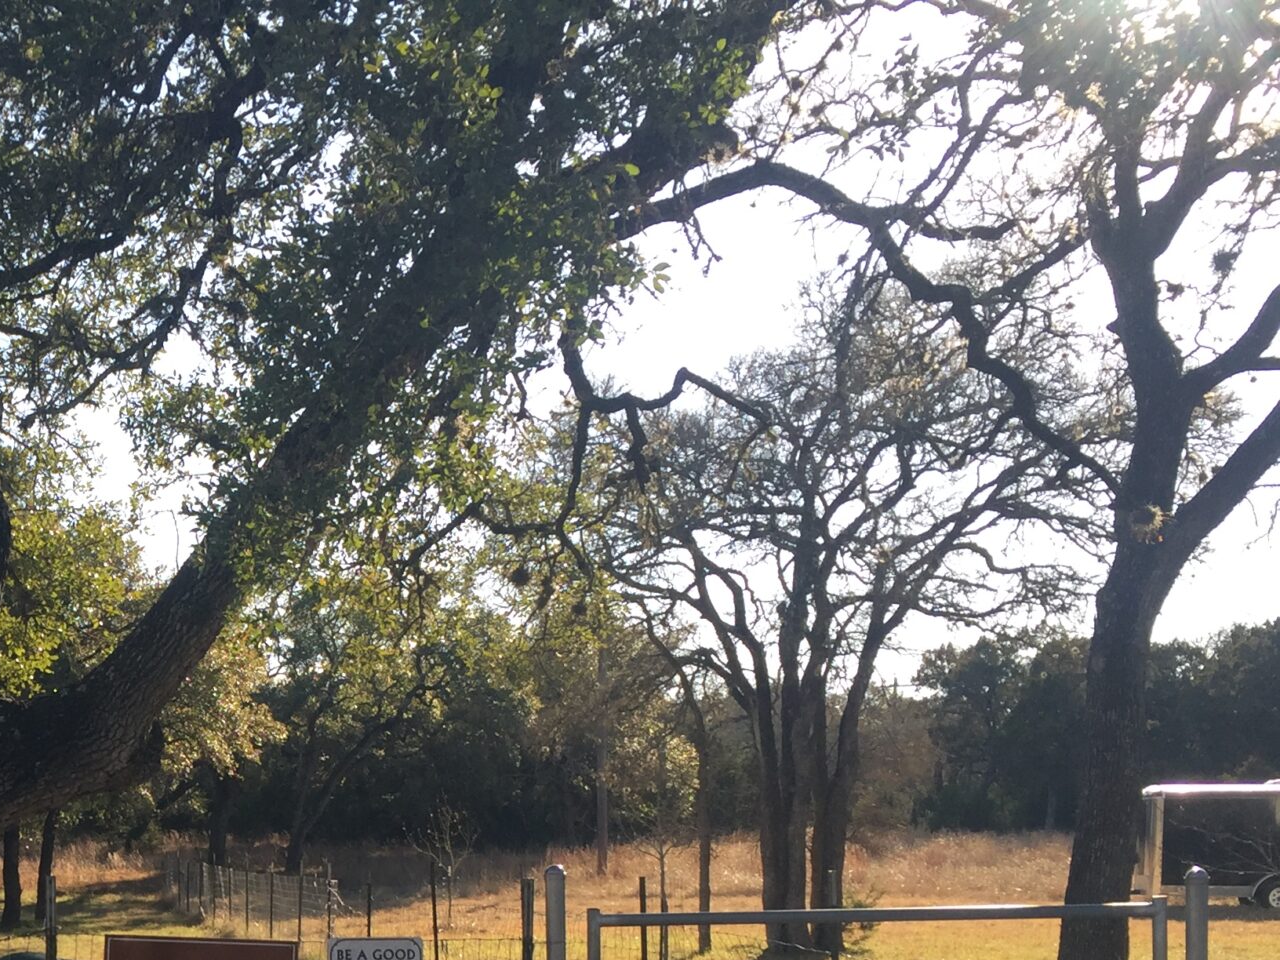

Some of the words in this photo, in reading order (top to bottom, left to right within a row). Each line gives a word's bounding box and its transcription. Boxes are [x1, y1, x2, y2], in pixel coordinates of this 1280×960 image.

[336, 949, 352, 960] BE
[357, 949, 368, 960] A
[372, 948, 416, 960] GOOD
